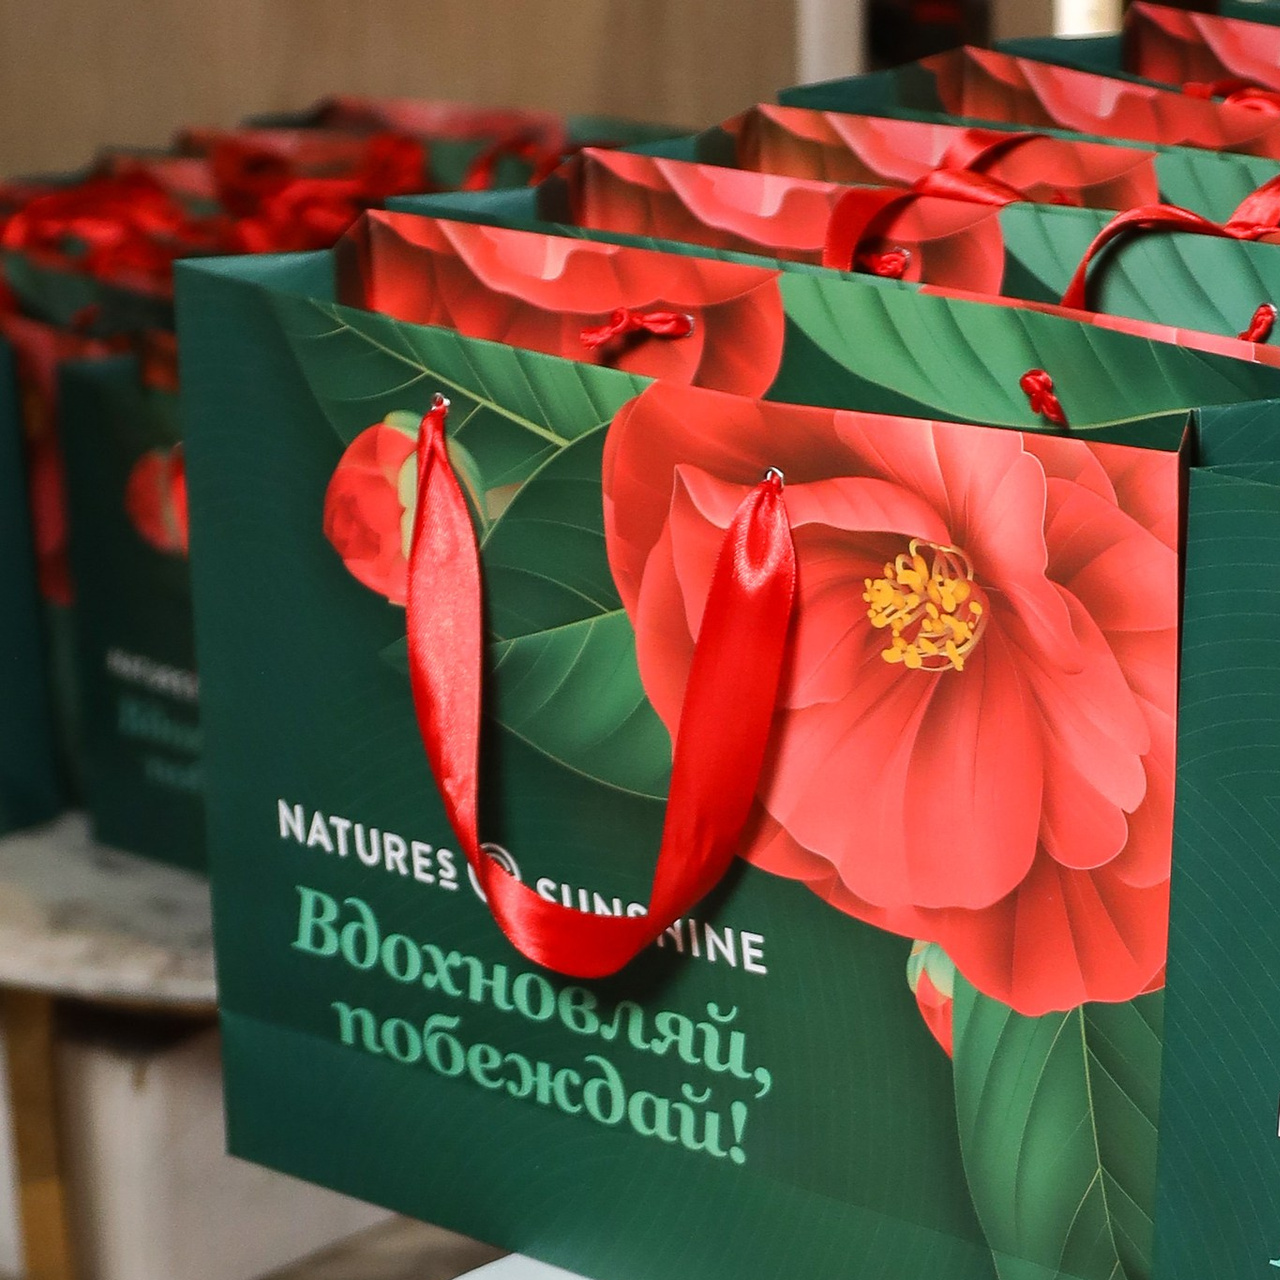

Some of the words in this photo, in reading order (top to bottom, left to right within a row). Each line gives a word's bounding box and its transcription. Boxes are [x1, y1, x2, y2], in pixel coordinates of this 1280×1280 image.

[278, 799, 459, 890] NATURES
[291, 885, 772, 1098] Вдохновляй,
[331, 1001, 748, 1164] побеждай!
